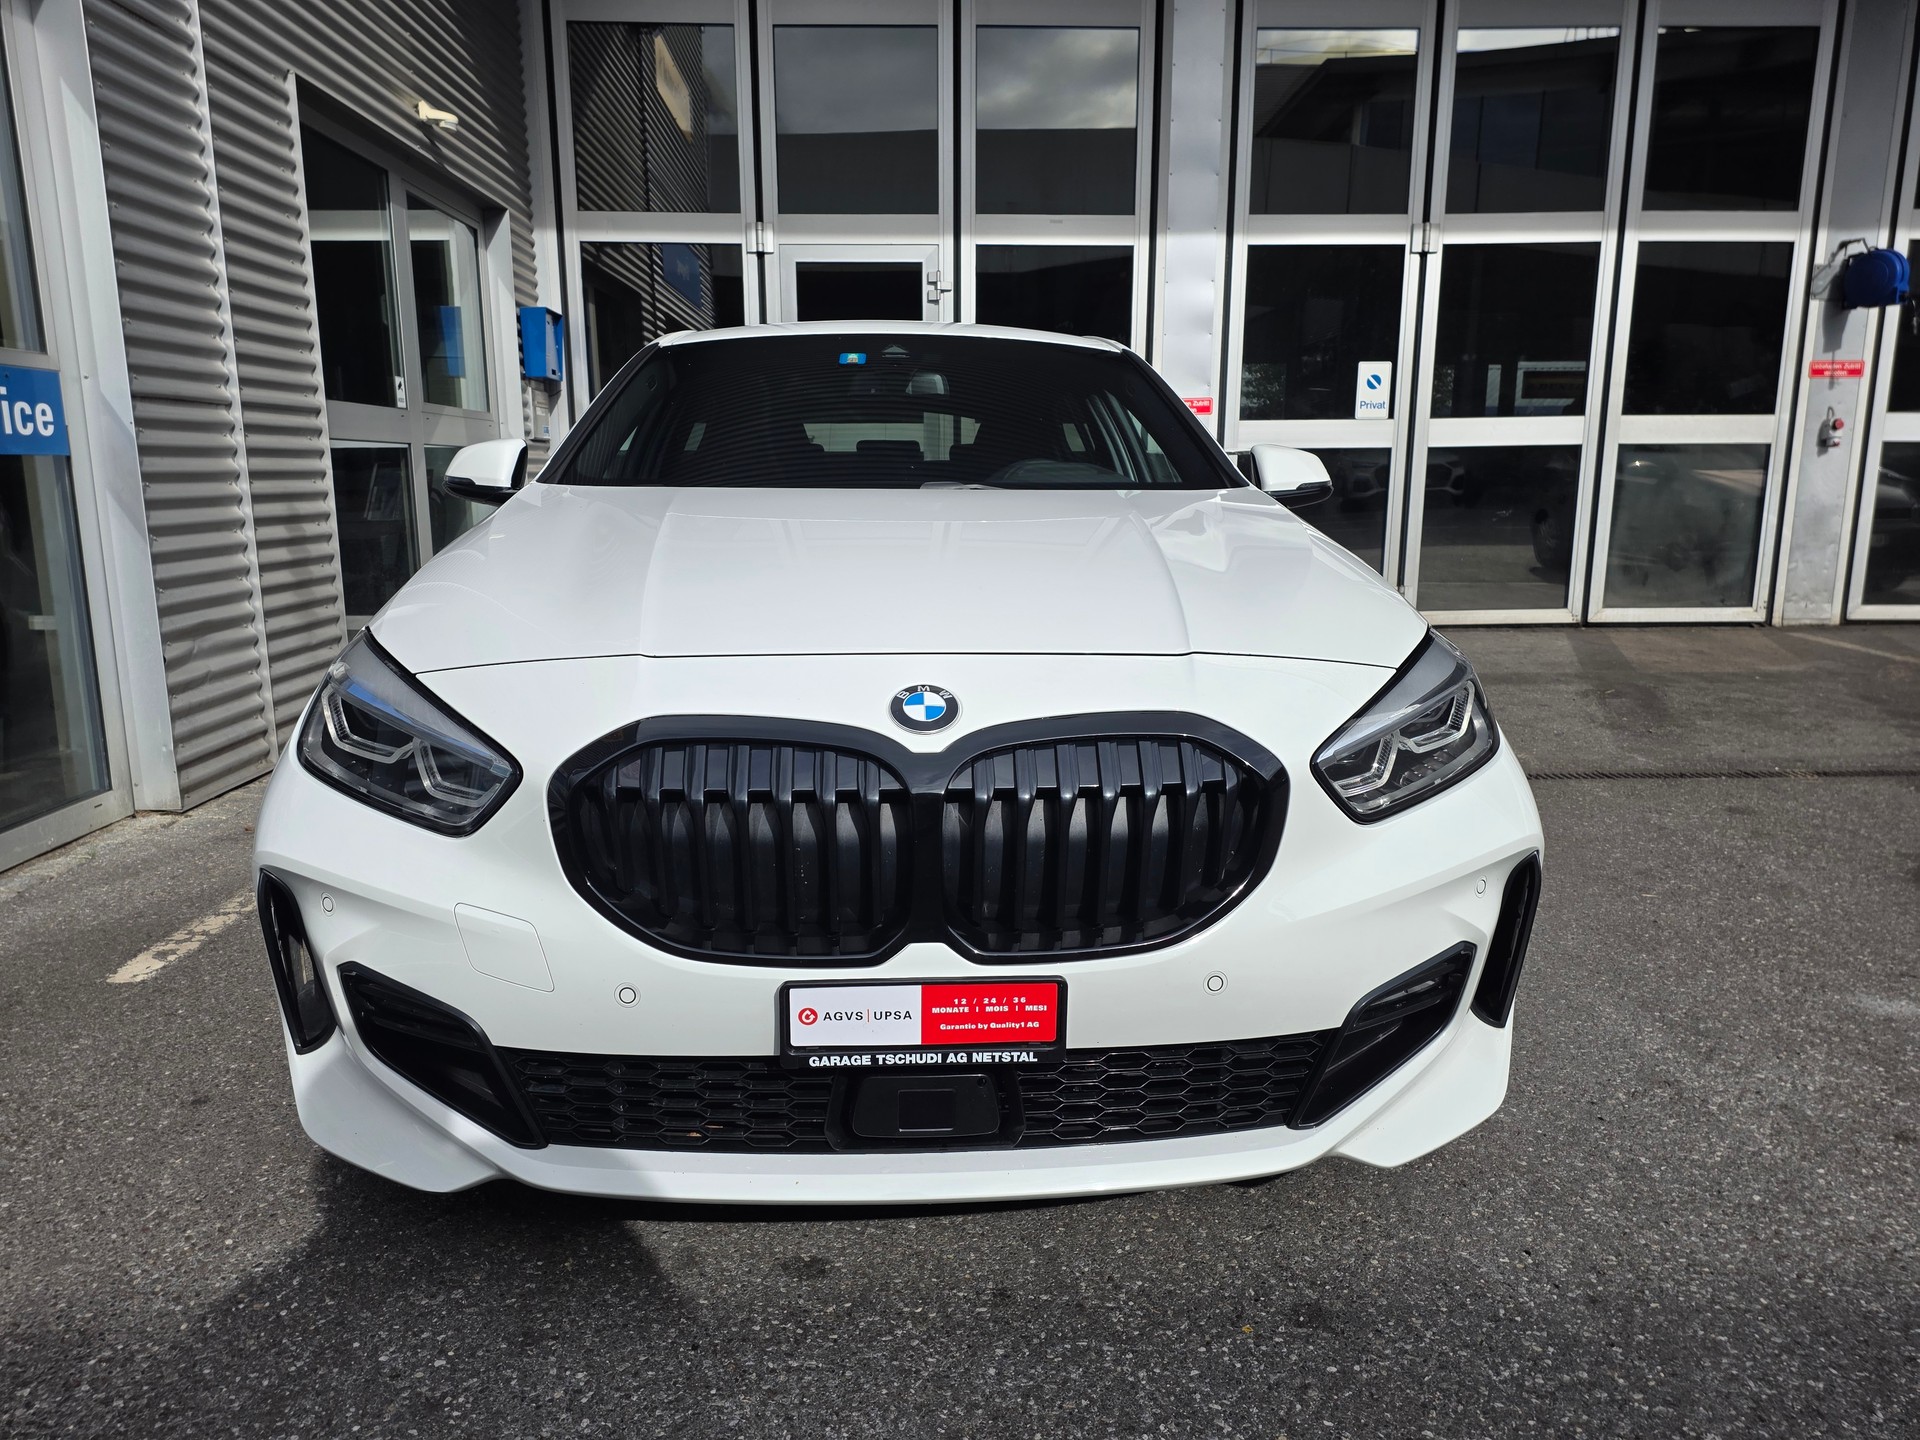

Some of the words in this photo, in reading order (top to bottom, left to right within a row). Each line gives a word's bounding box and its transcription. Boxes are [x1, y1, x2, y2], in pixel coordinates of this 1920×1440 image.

[1359, 400, 1386, 410] Privat
[896, 685, 953, 700] BMW
[1013, 996, 1027, 1004] 36
[931, 1006, 970, 1014] MONATE
[985, 1005, 1009, 1013] MOIS
[1025, 1004, 1048, 1012] MESI
[823, 1011, 864, 1021] AGVS
[873, 1010, 913, 1021] UPSA
[977, 1022, 988, 1030] by
[990, 1021, 1025, 1030] Quality1
[1026, 1021, 1040, 1029] AG
[808, 1054, 872, 1067] GARAGE
[876, 1053, 942, 1066] TSCHUDI
[946, 1052, 968, 1064] AG
[972, 1051, 1038, 1064] NETSTAL
